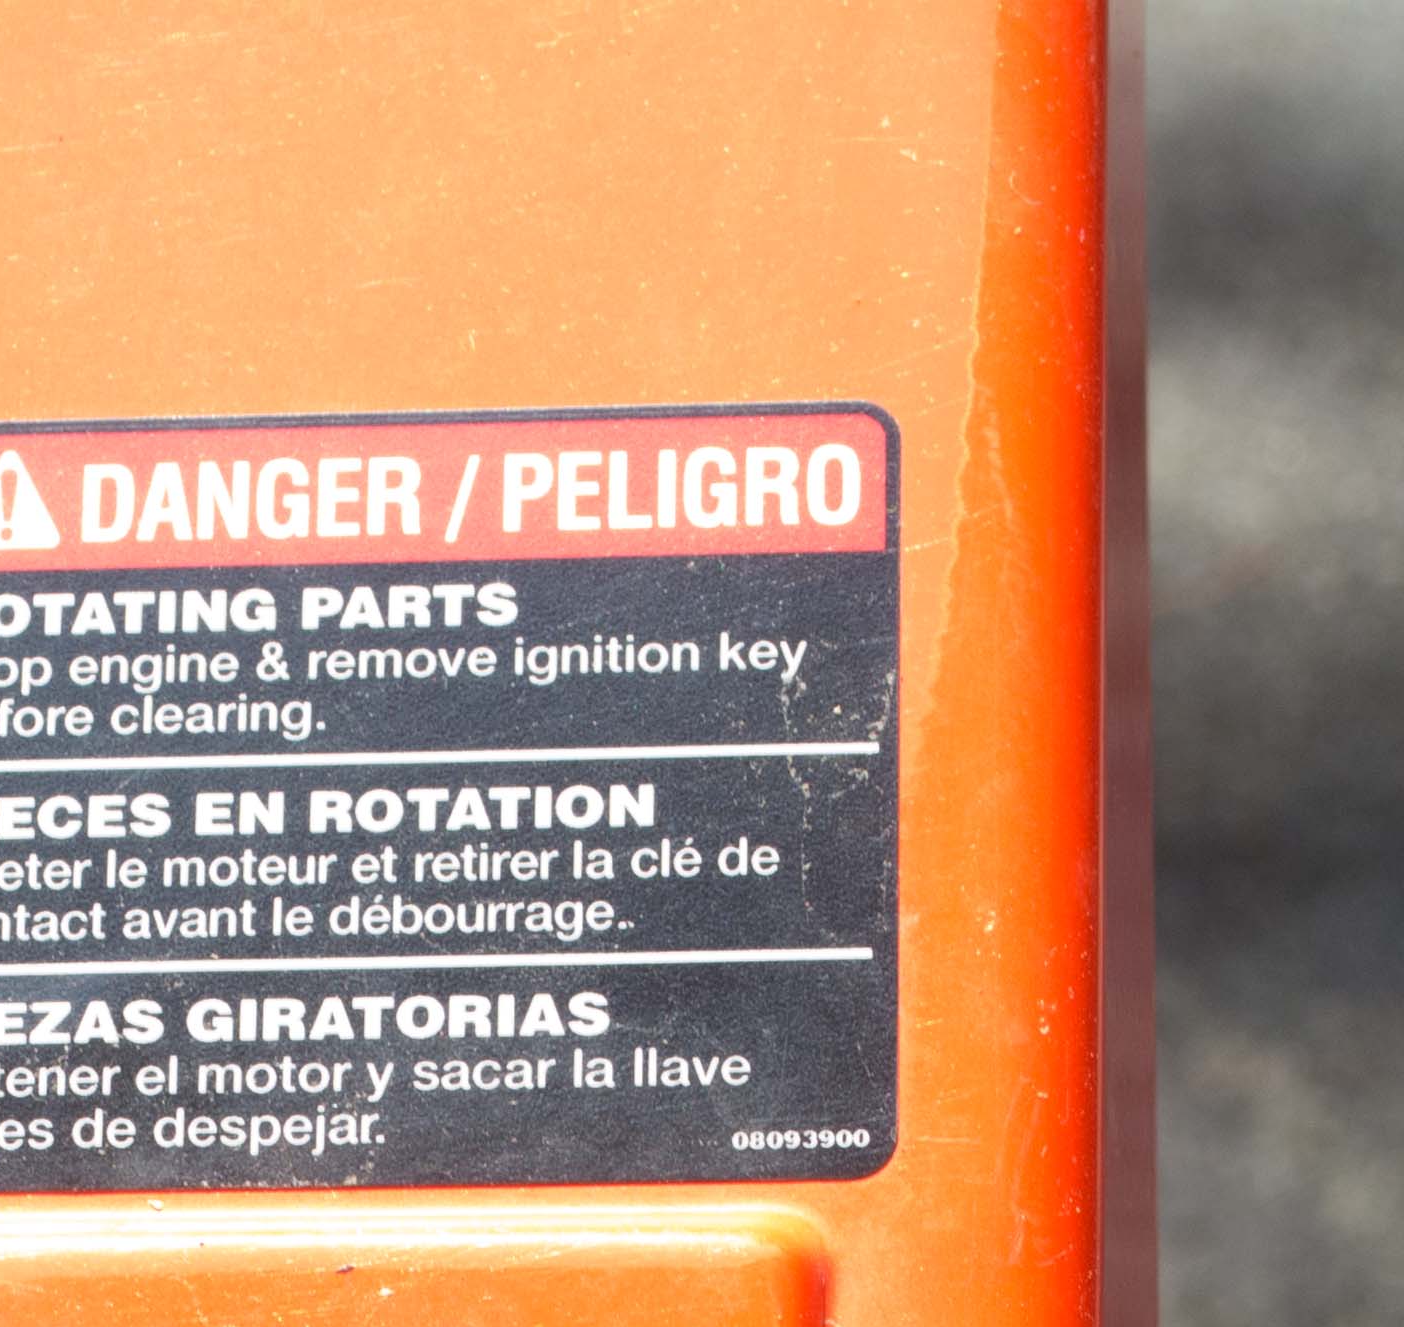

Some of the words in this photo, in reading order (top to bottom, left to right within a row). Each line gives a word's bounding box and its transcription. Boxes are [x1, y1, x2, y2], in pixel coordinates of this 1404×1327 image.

[78, 453, 422, 544] DANGER
[444, 454, 482, 544] /
[502, 443, 863, 533] PELIGRO
[302, 581, 518, 632] PARTS
[69, 644, 239, 694] engine
[256, 641, 290, 681] &
[308, 646, 497, 679] remove
[515, 634, 699, 685] ignition
[720, 632, 807, 683] key
[111, 693, 326, 741] clearing.
[195, 791, 285, 835] EN
[310, 784, 655, 833] ROTATION
[107, 849, 147, 888] le
[163, 853, 337, 887] moteur
[352, 846, 397, 883] et
[415, 842, 559, 882] retirer
[573, 840, 614, 879] la
[631, 837, 702, 878] clé
[718, 837, 779, 876] de
[123, 900, 256, 939] avant
[273, 897, 313, 936] le
[186, 992, 610, 1042] GIRATORIAS
[136, 1055, 178, 1095] el
[198, 1056, 352, 1094] motor
[367, 1062, 394, 1102] y
[413, 1058, 556, 1091] sacar
[573, 1048, 615, 1088] la
[634, 1047, 751, 1086] llave
[72, 1108, 136, 1148] de
[153, 1105, 385, 1156] despejar.
[731, 1129, 871, 1150] 08093900
